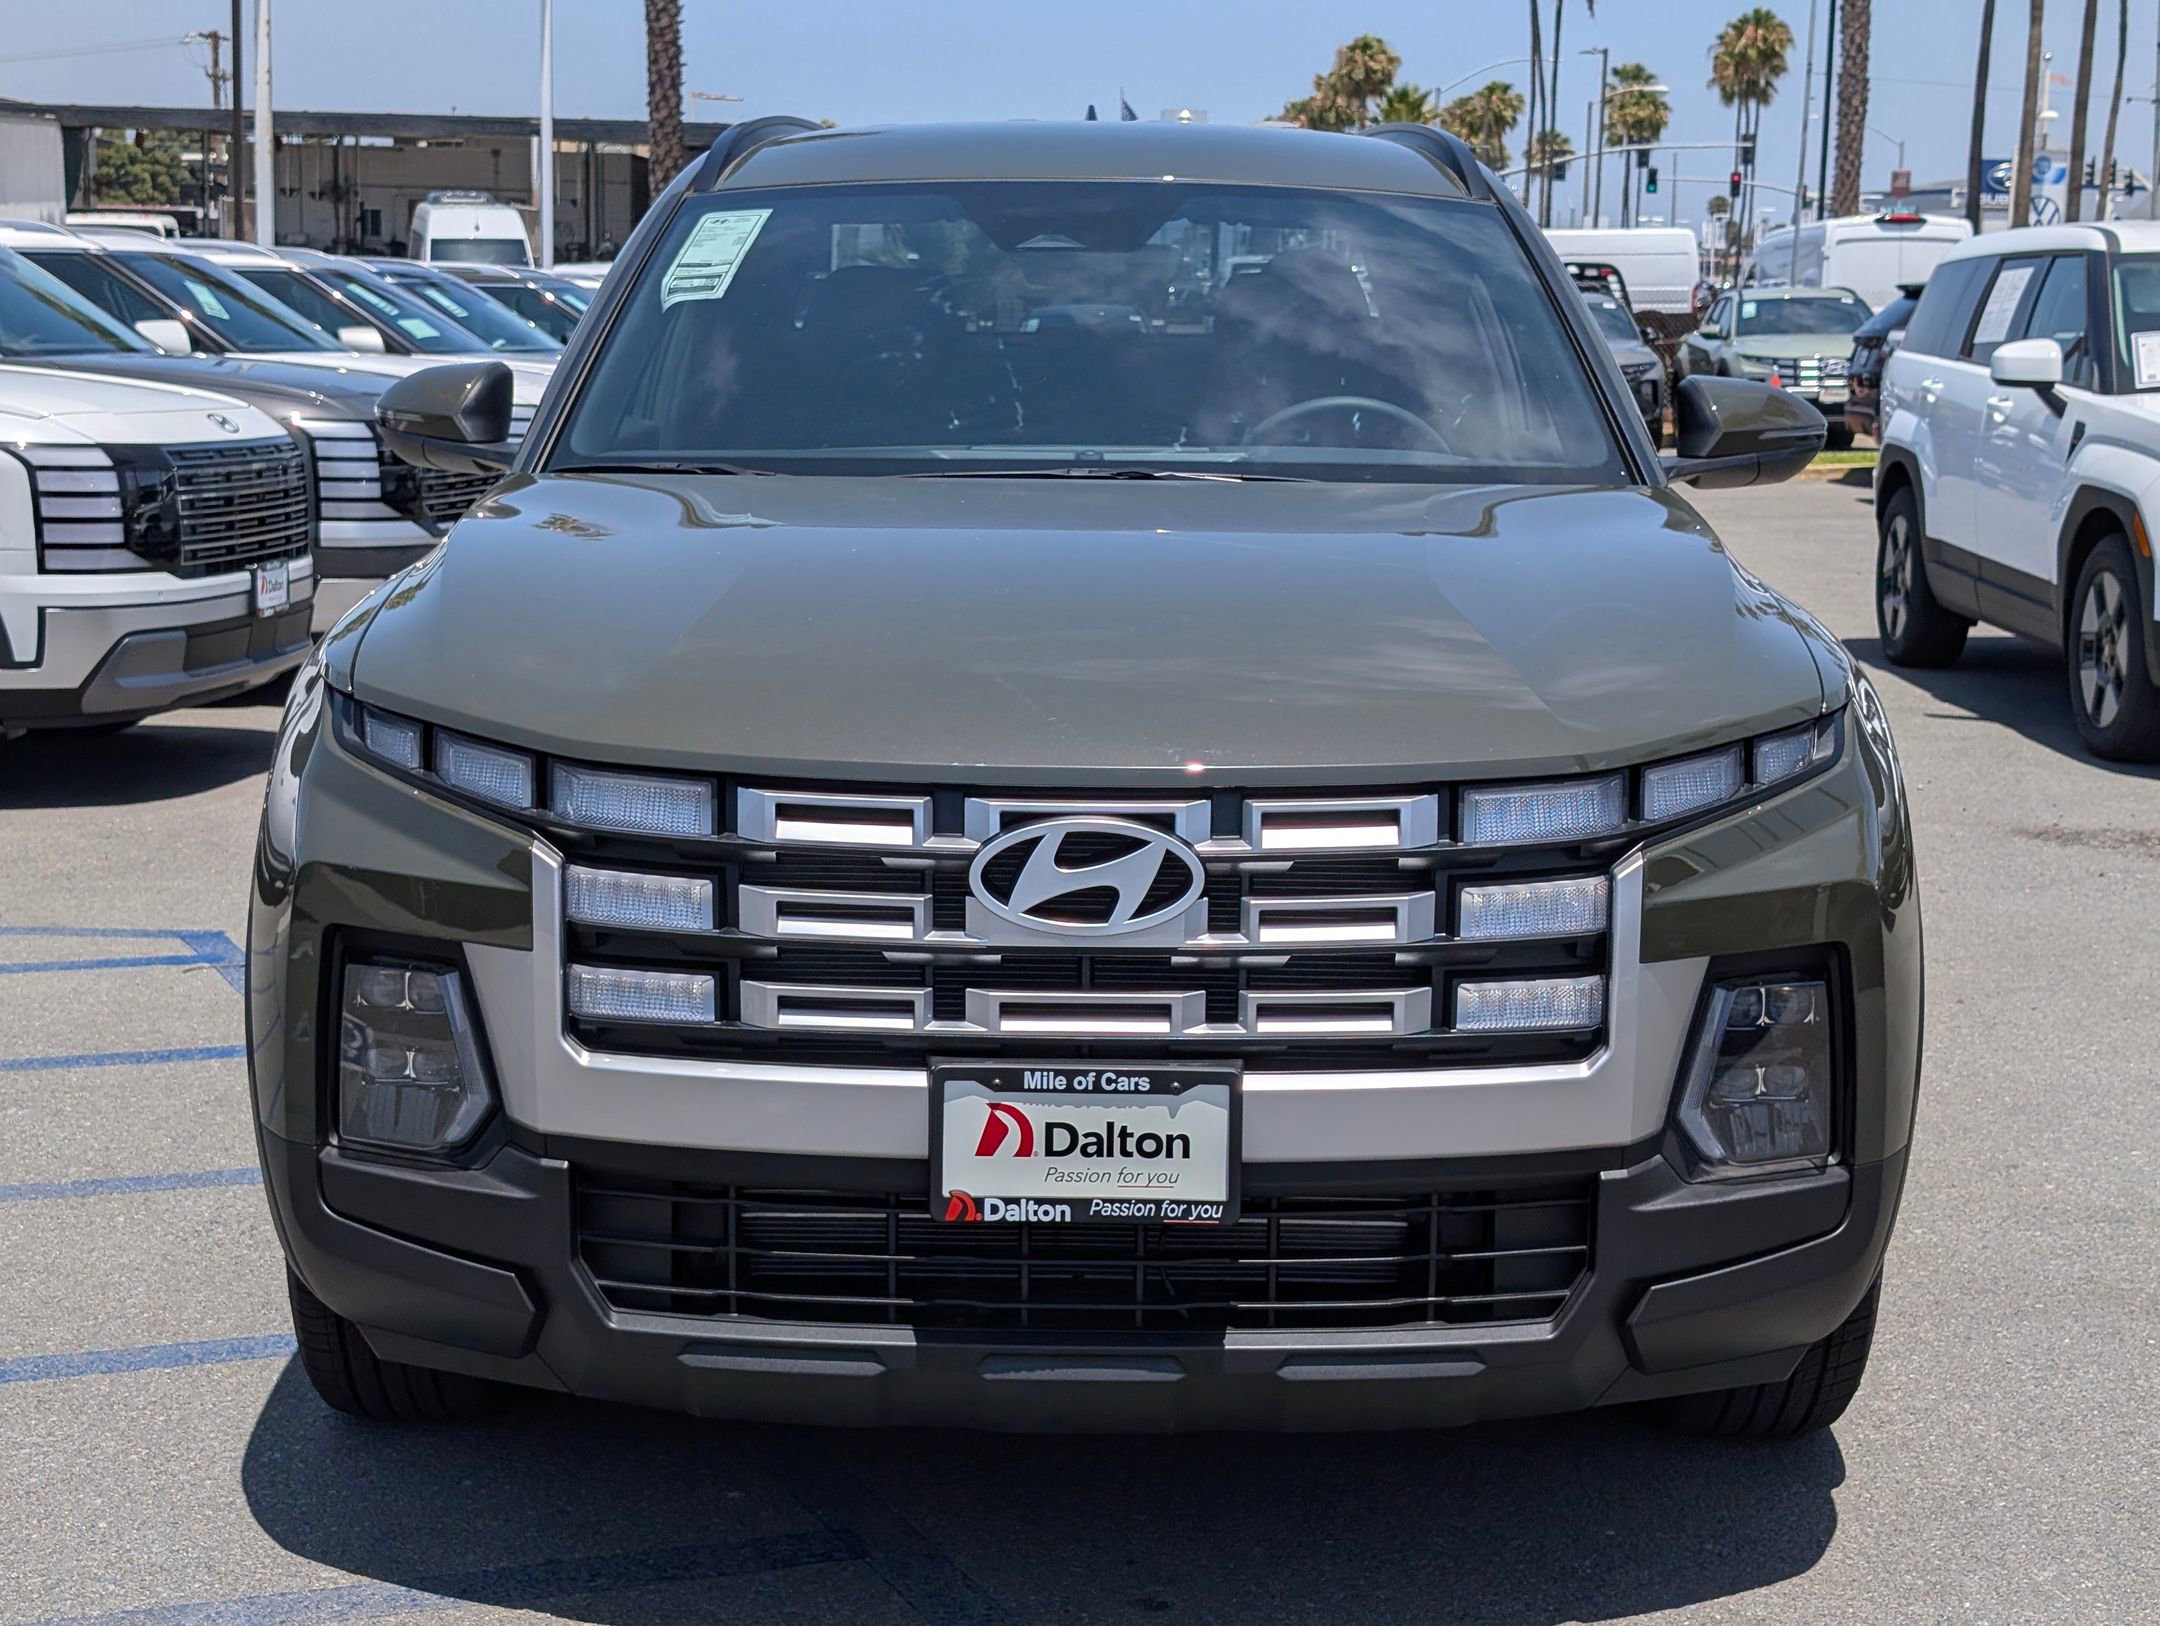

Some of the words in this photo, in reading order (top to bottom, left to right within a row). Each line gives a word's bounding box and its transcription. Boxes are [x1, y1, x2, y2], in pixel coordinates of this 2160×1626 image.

[1023, 1071, 1067, 1090] Mile
[1073, 1072, 1096, 1090] of
[1101, 1072, 1150, 1091] Cars
[1044, 1121, 1190, 1159] Dalton
[1044, 1167, 1111, 1183] Passion
[1117, 1167, 1143, 1185] for
[1147, 1171, 1180, 1187] you
[984, 1198, 1071, 1222] Dalton
[1090, 1200, 1155, 1217] Passion
[1160, 1200, 1188, 1219] for
[1188, 1204, 1223, 1221] you
